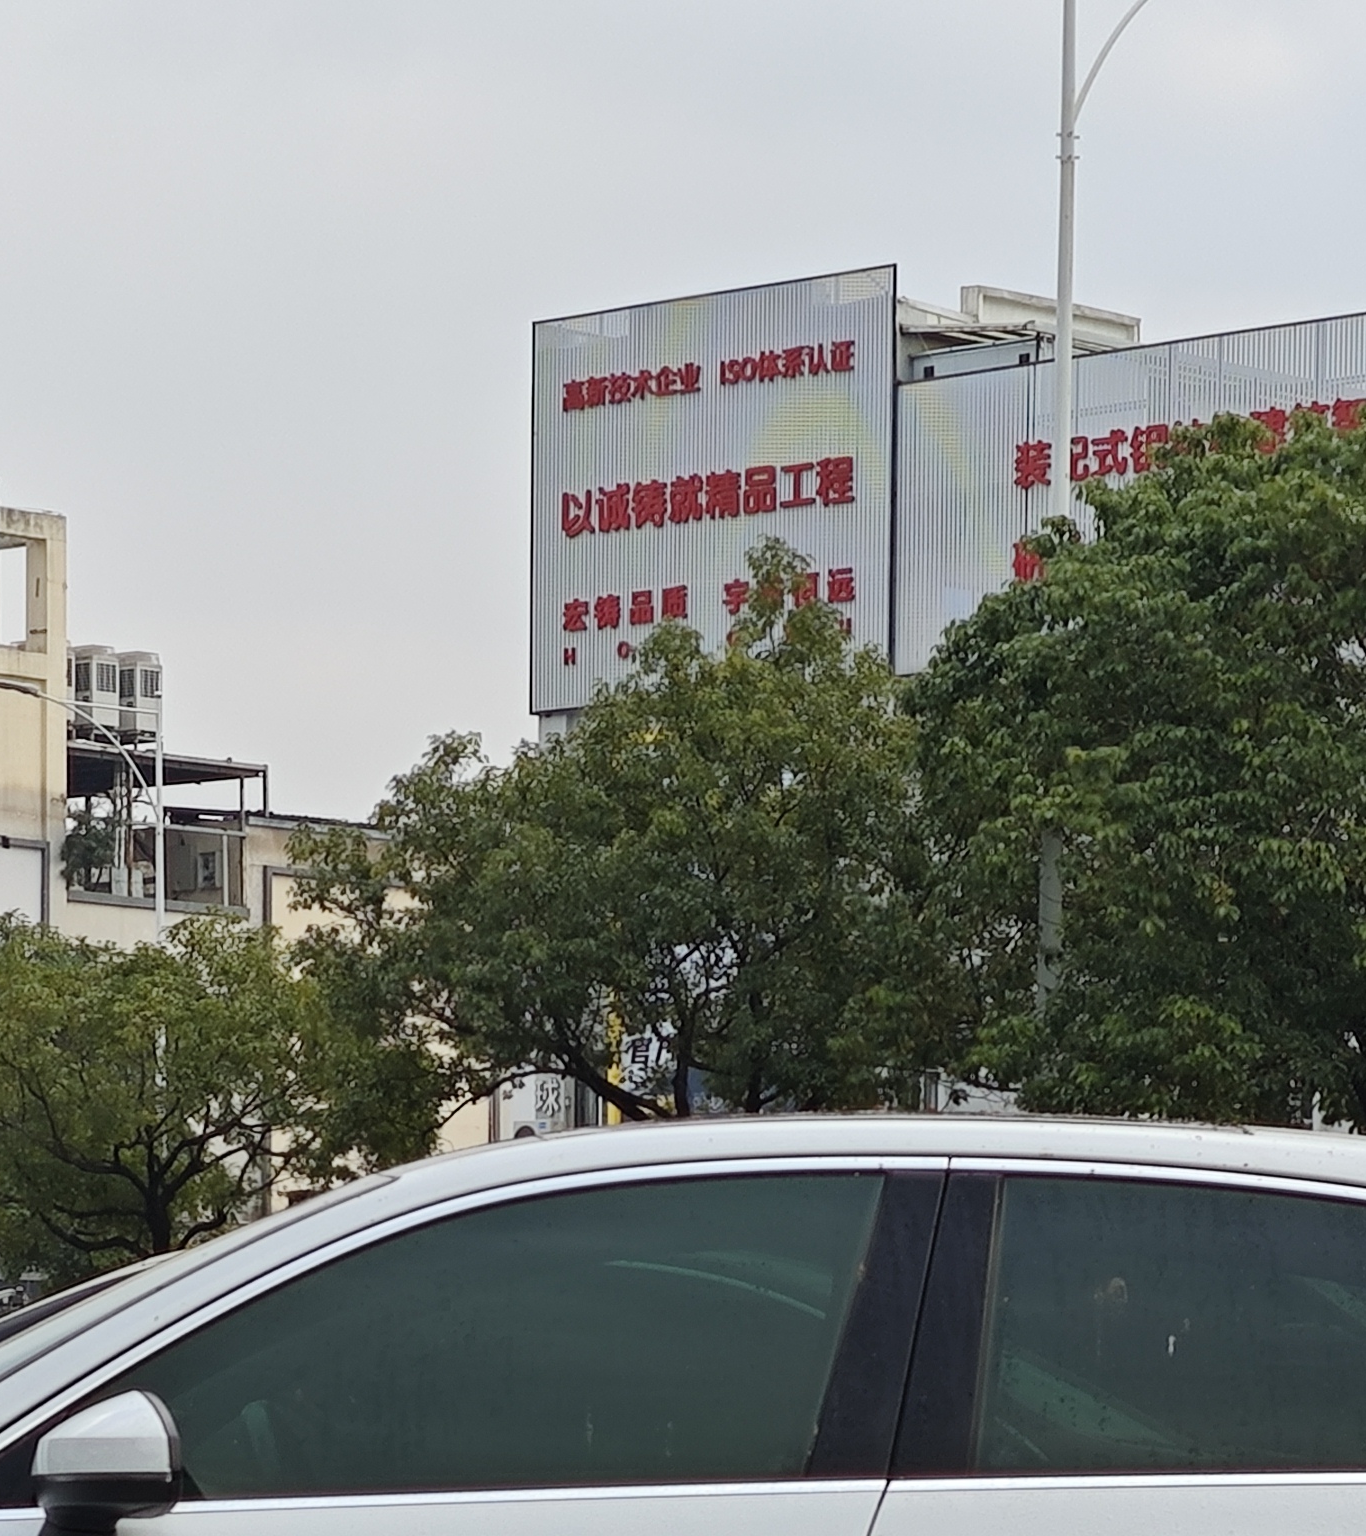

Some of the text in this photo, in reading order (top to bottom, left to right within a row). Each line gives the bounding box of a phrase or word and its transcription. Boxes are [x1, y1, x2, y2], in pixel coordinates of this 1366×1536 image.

[563, 340, 855, 412] 高新技术企业 ISO体系认证
[561, 456, 855, 538] 以诚铸就精品工程
